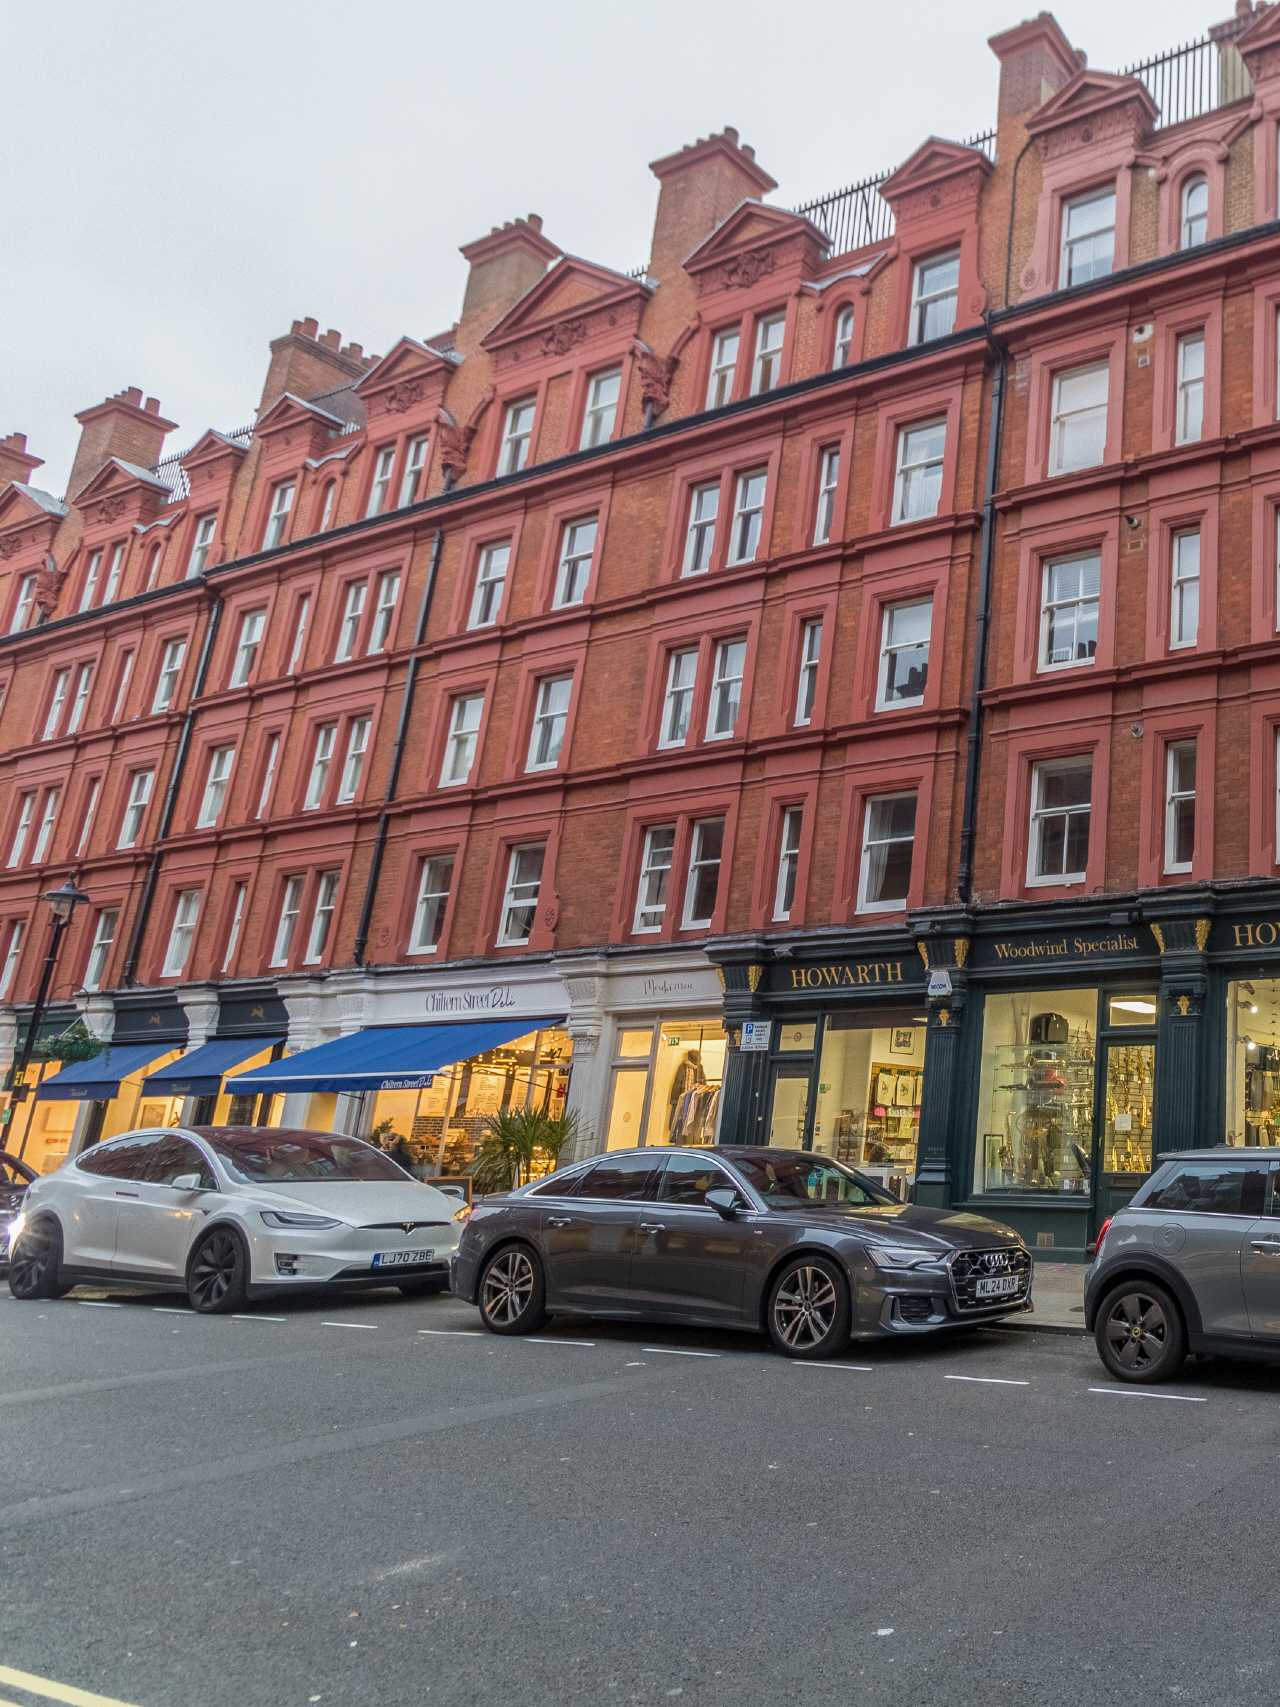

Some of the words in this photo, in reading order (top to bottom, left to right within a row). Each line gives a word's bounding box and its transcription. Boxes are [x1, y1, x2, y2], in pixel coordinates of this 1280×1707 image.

[993, 939, 1069, 959] Woodwind
[1073, 934, 1140, 957] Specialist
[791, 961, 904, 989] HOWARTH
[425, 991, 462, 1013] Chiltern
[463, 990, 491, 1010] Street
[490, 985, 515, 1009] Deli
[381, 1252, 410, 1265] LJ70
